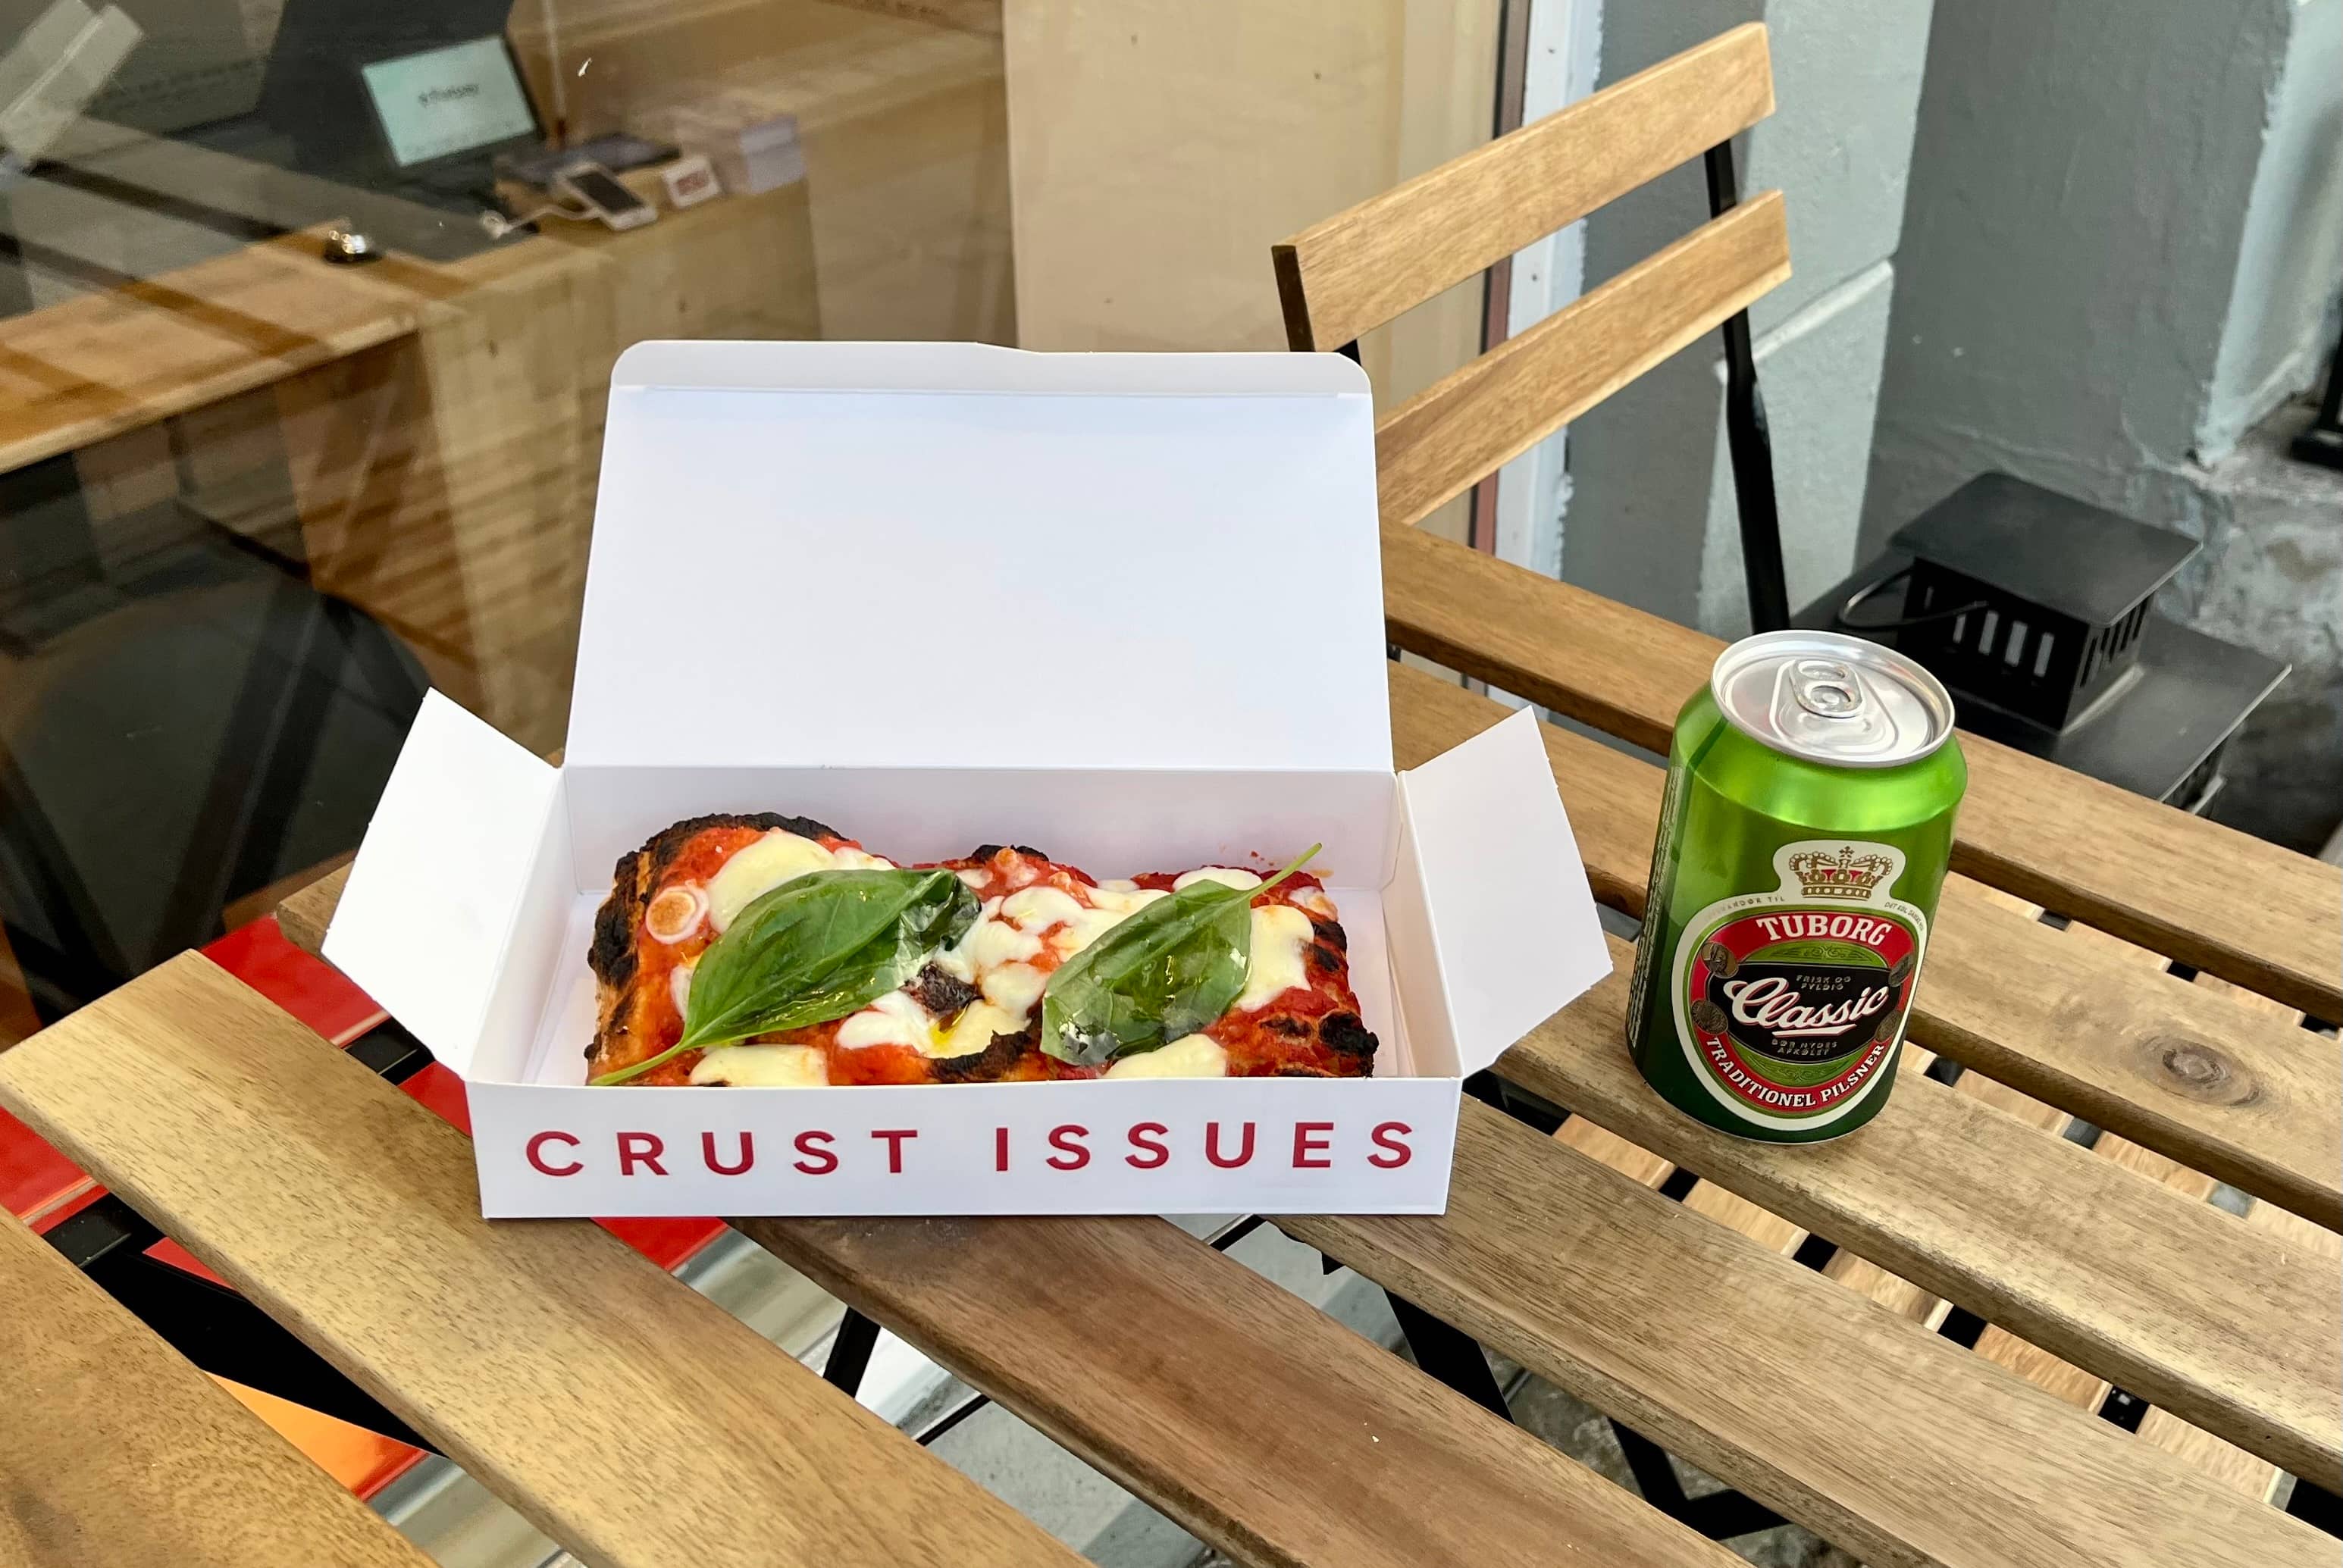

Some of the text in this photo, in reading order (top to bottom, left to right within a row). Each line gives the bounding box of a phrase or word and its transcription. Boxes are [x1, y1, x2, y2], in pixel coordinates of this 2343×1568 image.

[1756, 915, 1893, 946] TUBORG
[1724, 977, 1889, 1028] Classic
[1706, 1038, 1885, 1107] TRADITIONEL PILSNER
[526, 1122, 1411, 1176] CRUST ISSUES
